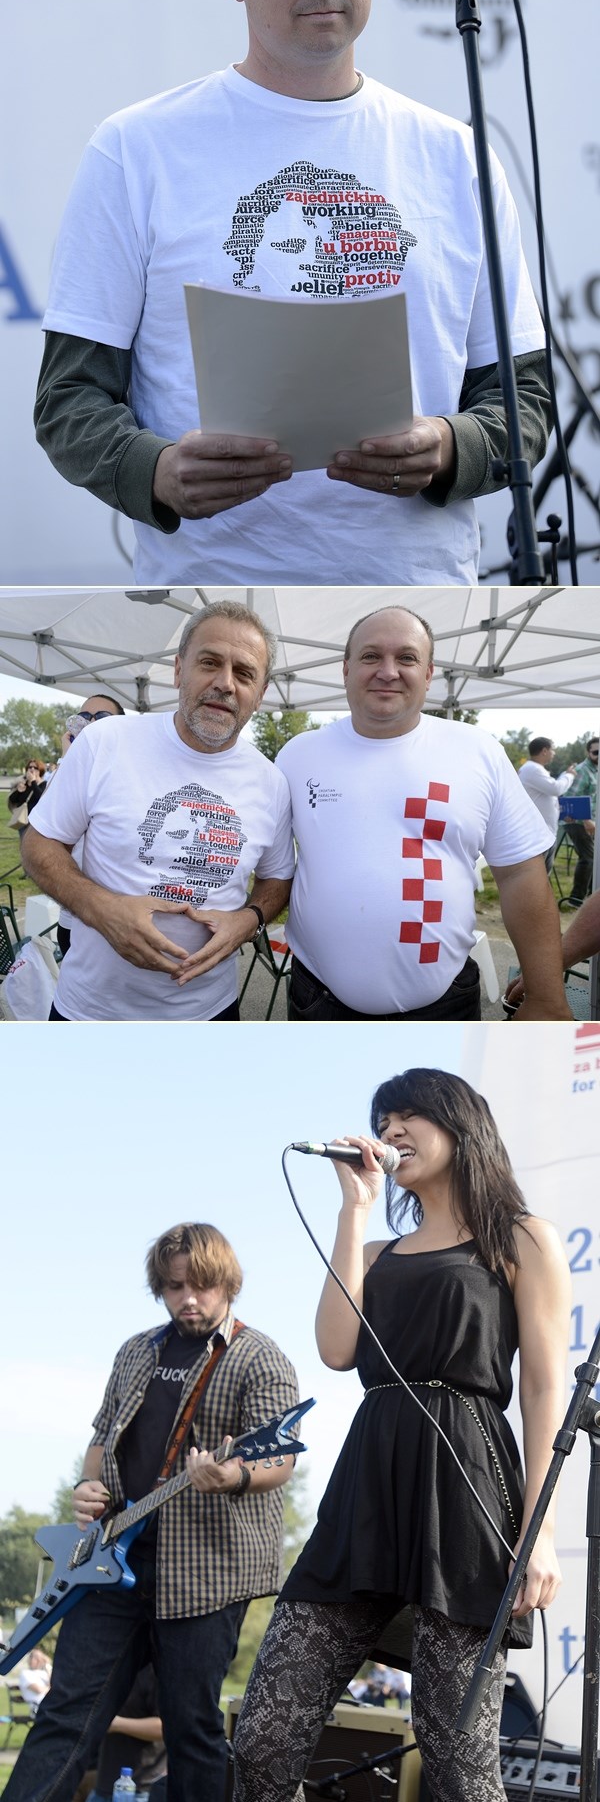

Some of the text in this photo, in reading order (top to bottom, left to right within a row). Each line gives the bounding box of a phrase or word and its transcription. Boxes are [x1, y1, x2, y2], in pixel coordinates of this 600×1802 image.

[267, 176, 316, 186] sacrifice
[306, 172, 356, 181] courage
[285, 191, 386, 205] zajedničkim
[302, 203, 377, 218] working
[232, 216, 265, 224] force
[346, 221, 384, 231] belief
[340, 230, 397, 240] snagama
[323, 238, 398, 254] u borbu
[344, 249, 407, 264] together
[298, 263, 404, 274] sacrifice persévérance
[345, 269, 402, 288] protiv
[180, 800, 236, 815] zajedničkim
[190, 809, 231, 824] working
[213, 822, 232, 832] belief
[199, 833, 238, 846] u borbu
[181, 845, 212, 854] sacrifice
[209, 841, 242, 852] together
[207, 854, 239, 866] protiv
[165, 884, 193, 896] raka
[170, 892, 208, 904] cancer
[573, 1062, 591, 1073] za
[572, 1079, 595, 1093] for
[152, 1366, 189, 1382] FUCK
